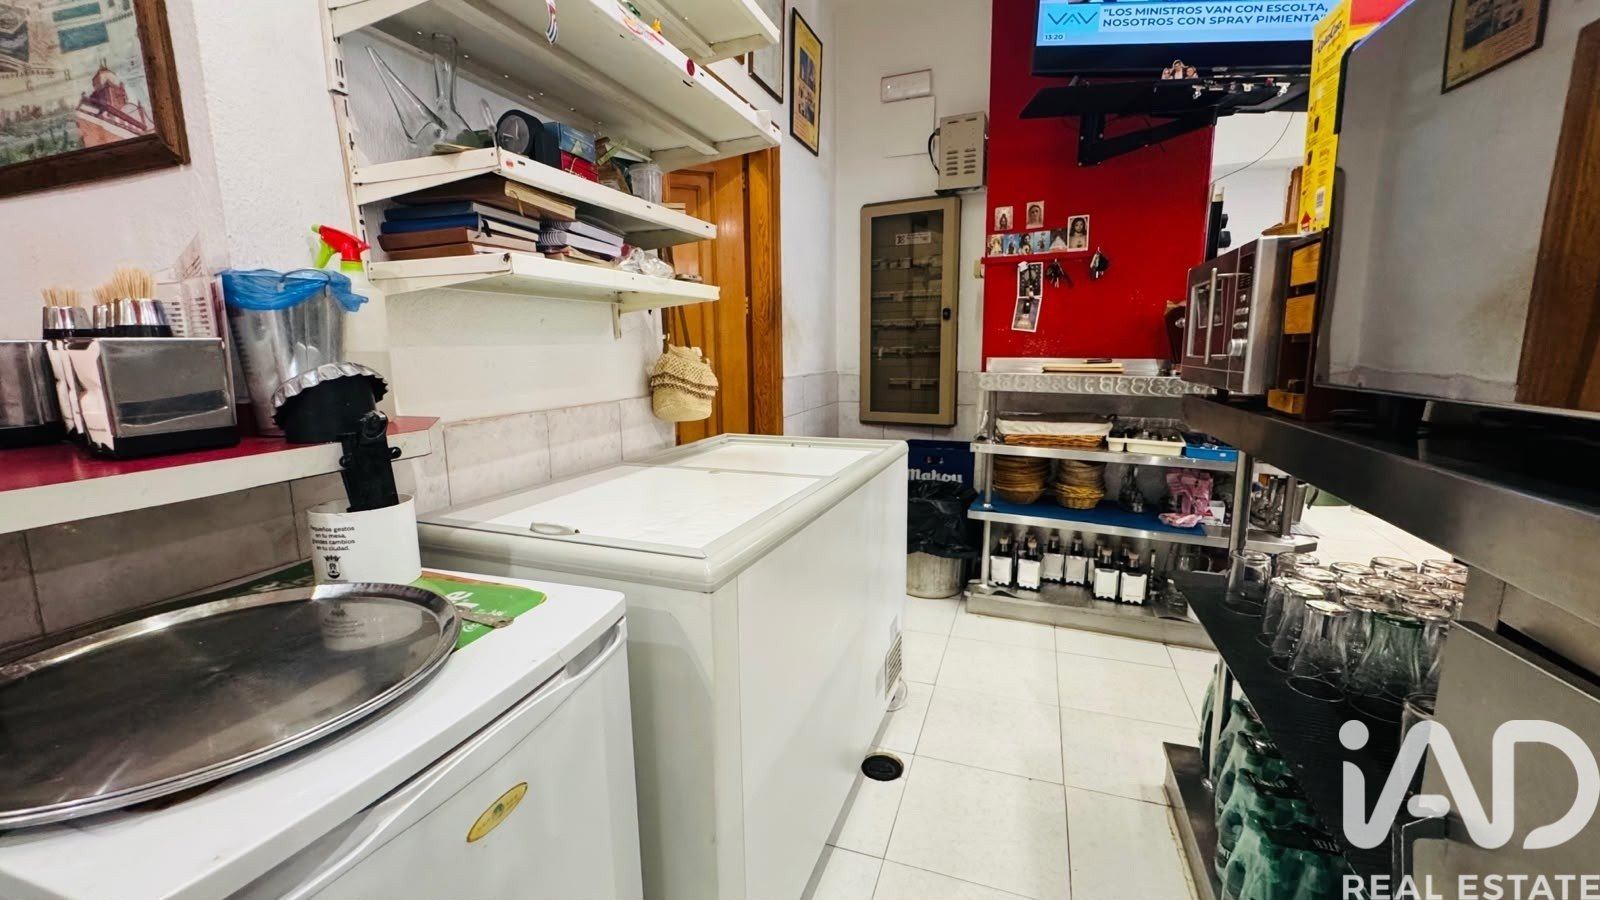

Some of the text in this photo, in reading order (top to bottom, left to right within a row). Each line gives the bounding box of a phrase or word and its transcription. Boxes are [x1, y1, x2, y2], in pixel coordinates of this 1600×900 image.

[1103, 3, 1328, 17] "LOS MINISTROS VAN CON ESCOLTA,
[1103, 13, 1326, 27] NOSOTROS CON SPRAY PIMIENTA"
